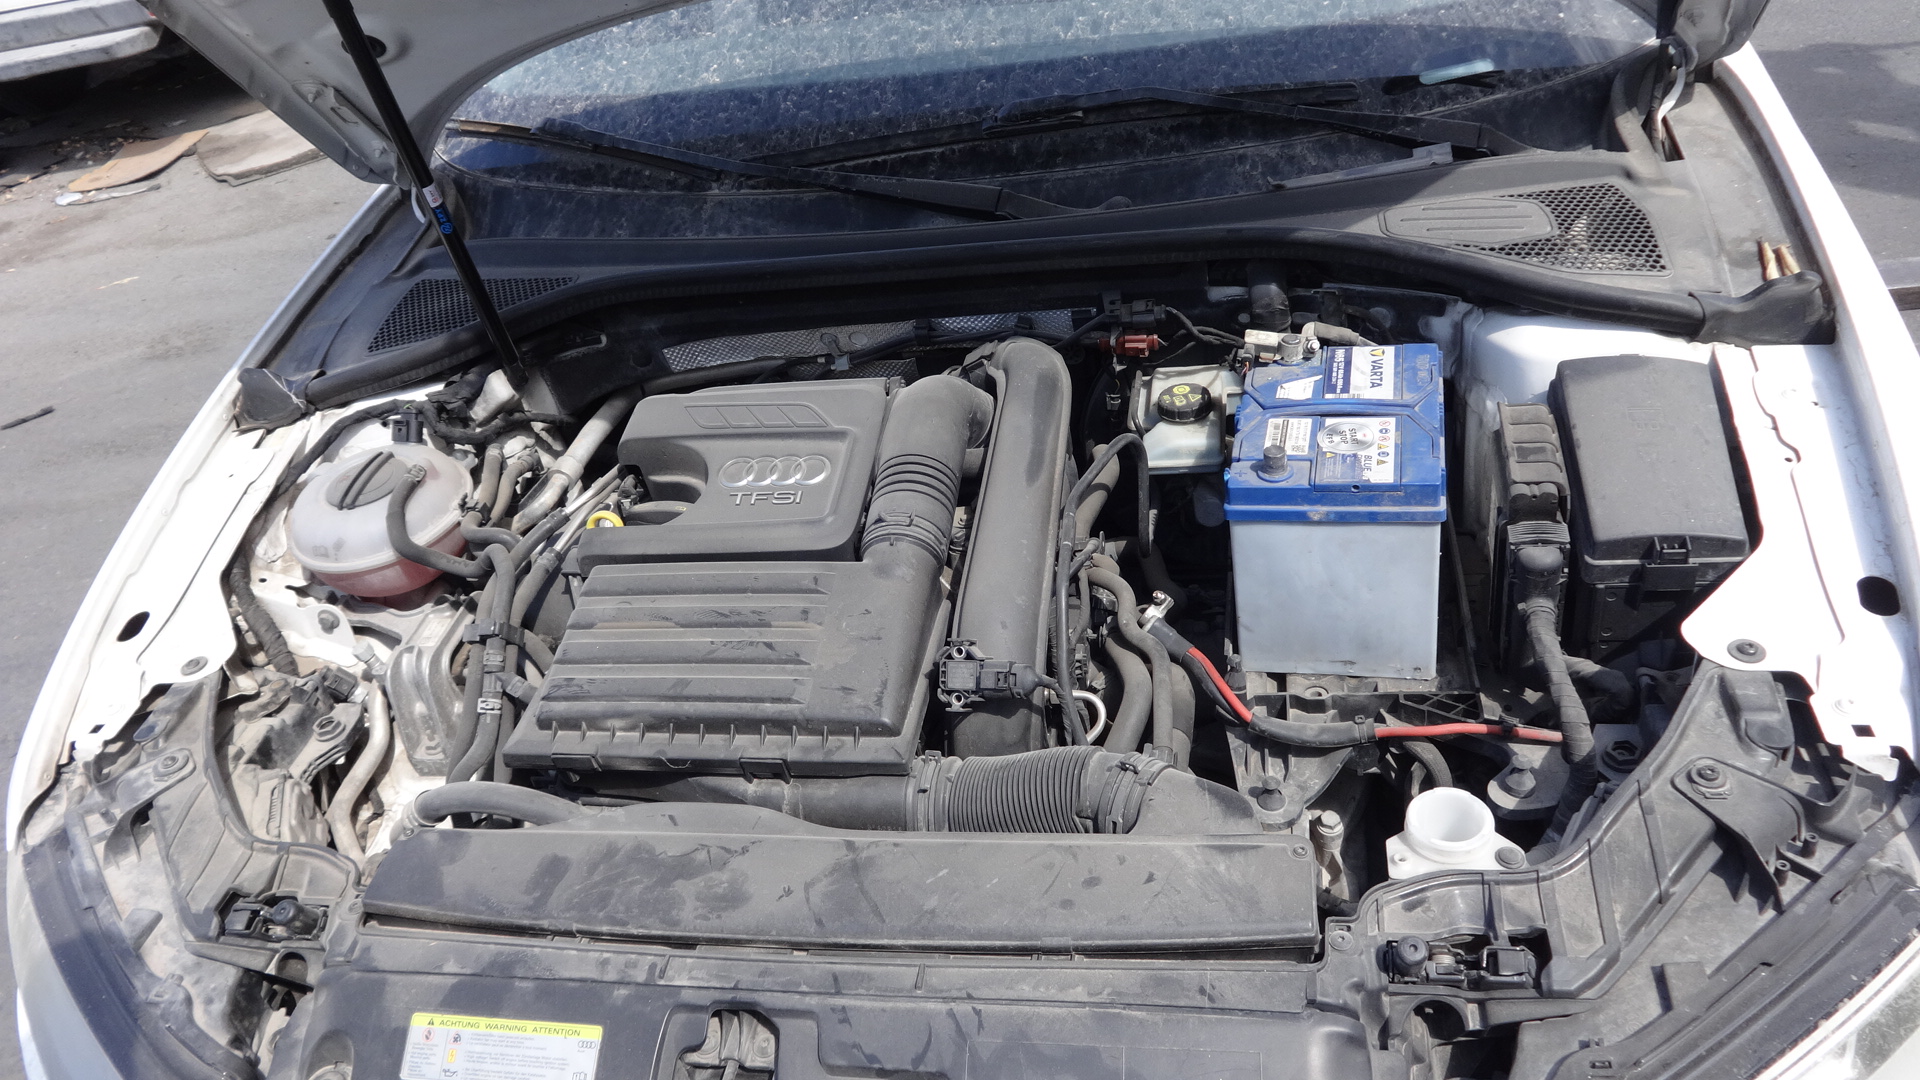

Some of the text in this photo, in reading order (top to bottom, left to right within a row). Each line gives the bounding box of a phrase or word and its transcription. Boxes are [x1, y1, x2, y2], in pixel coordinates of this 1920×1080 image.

[1370, 359, 1383, 389] VARTA
[1339, 430, 1349, 445] STOP
[1348, 427, 1359, 445] START
[1363, 454, 1373, 472] BLUE
[729, 490, 804, 506] TFSI
[439, 1019, 581, 1037] ACHTUNG WARNING ATTENTION
